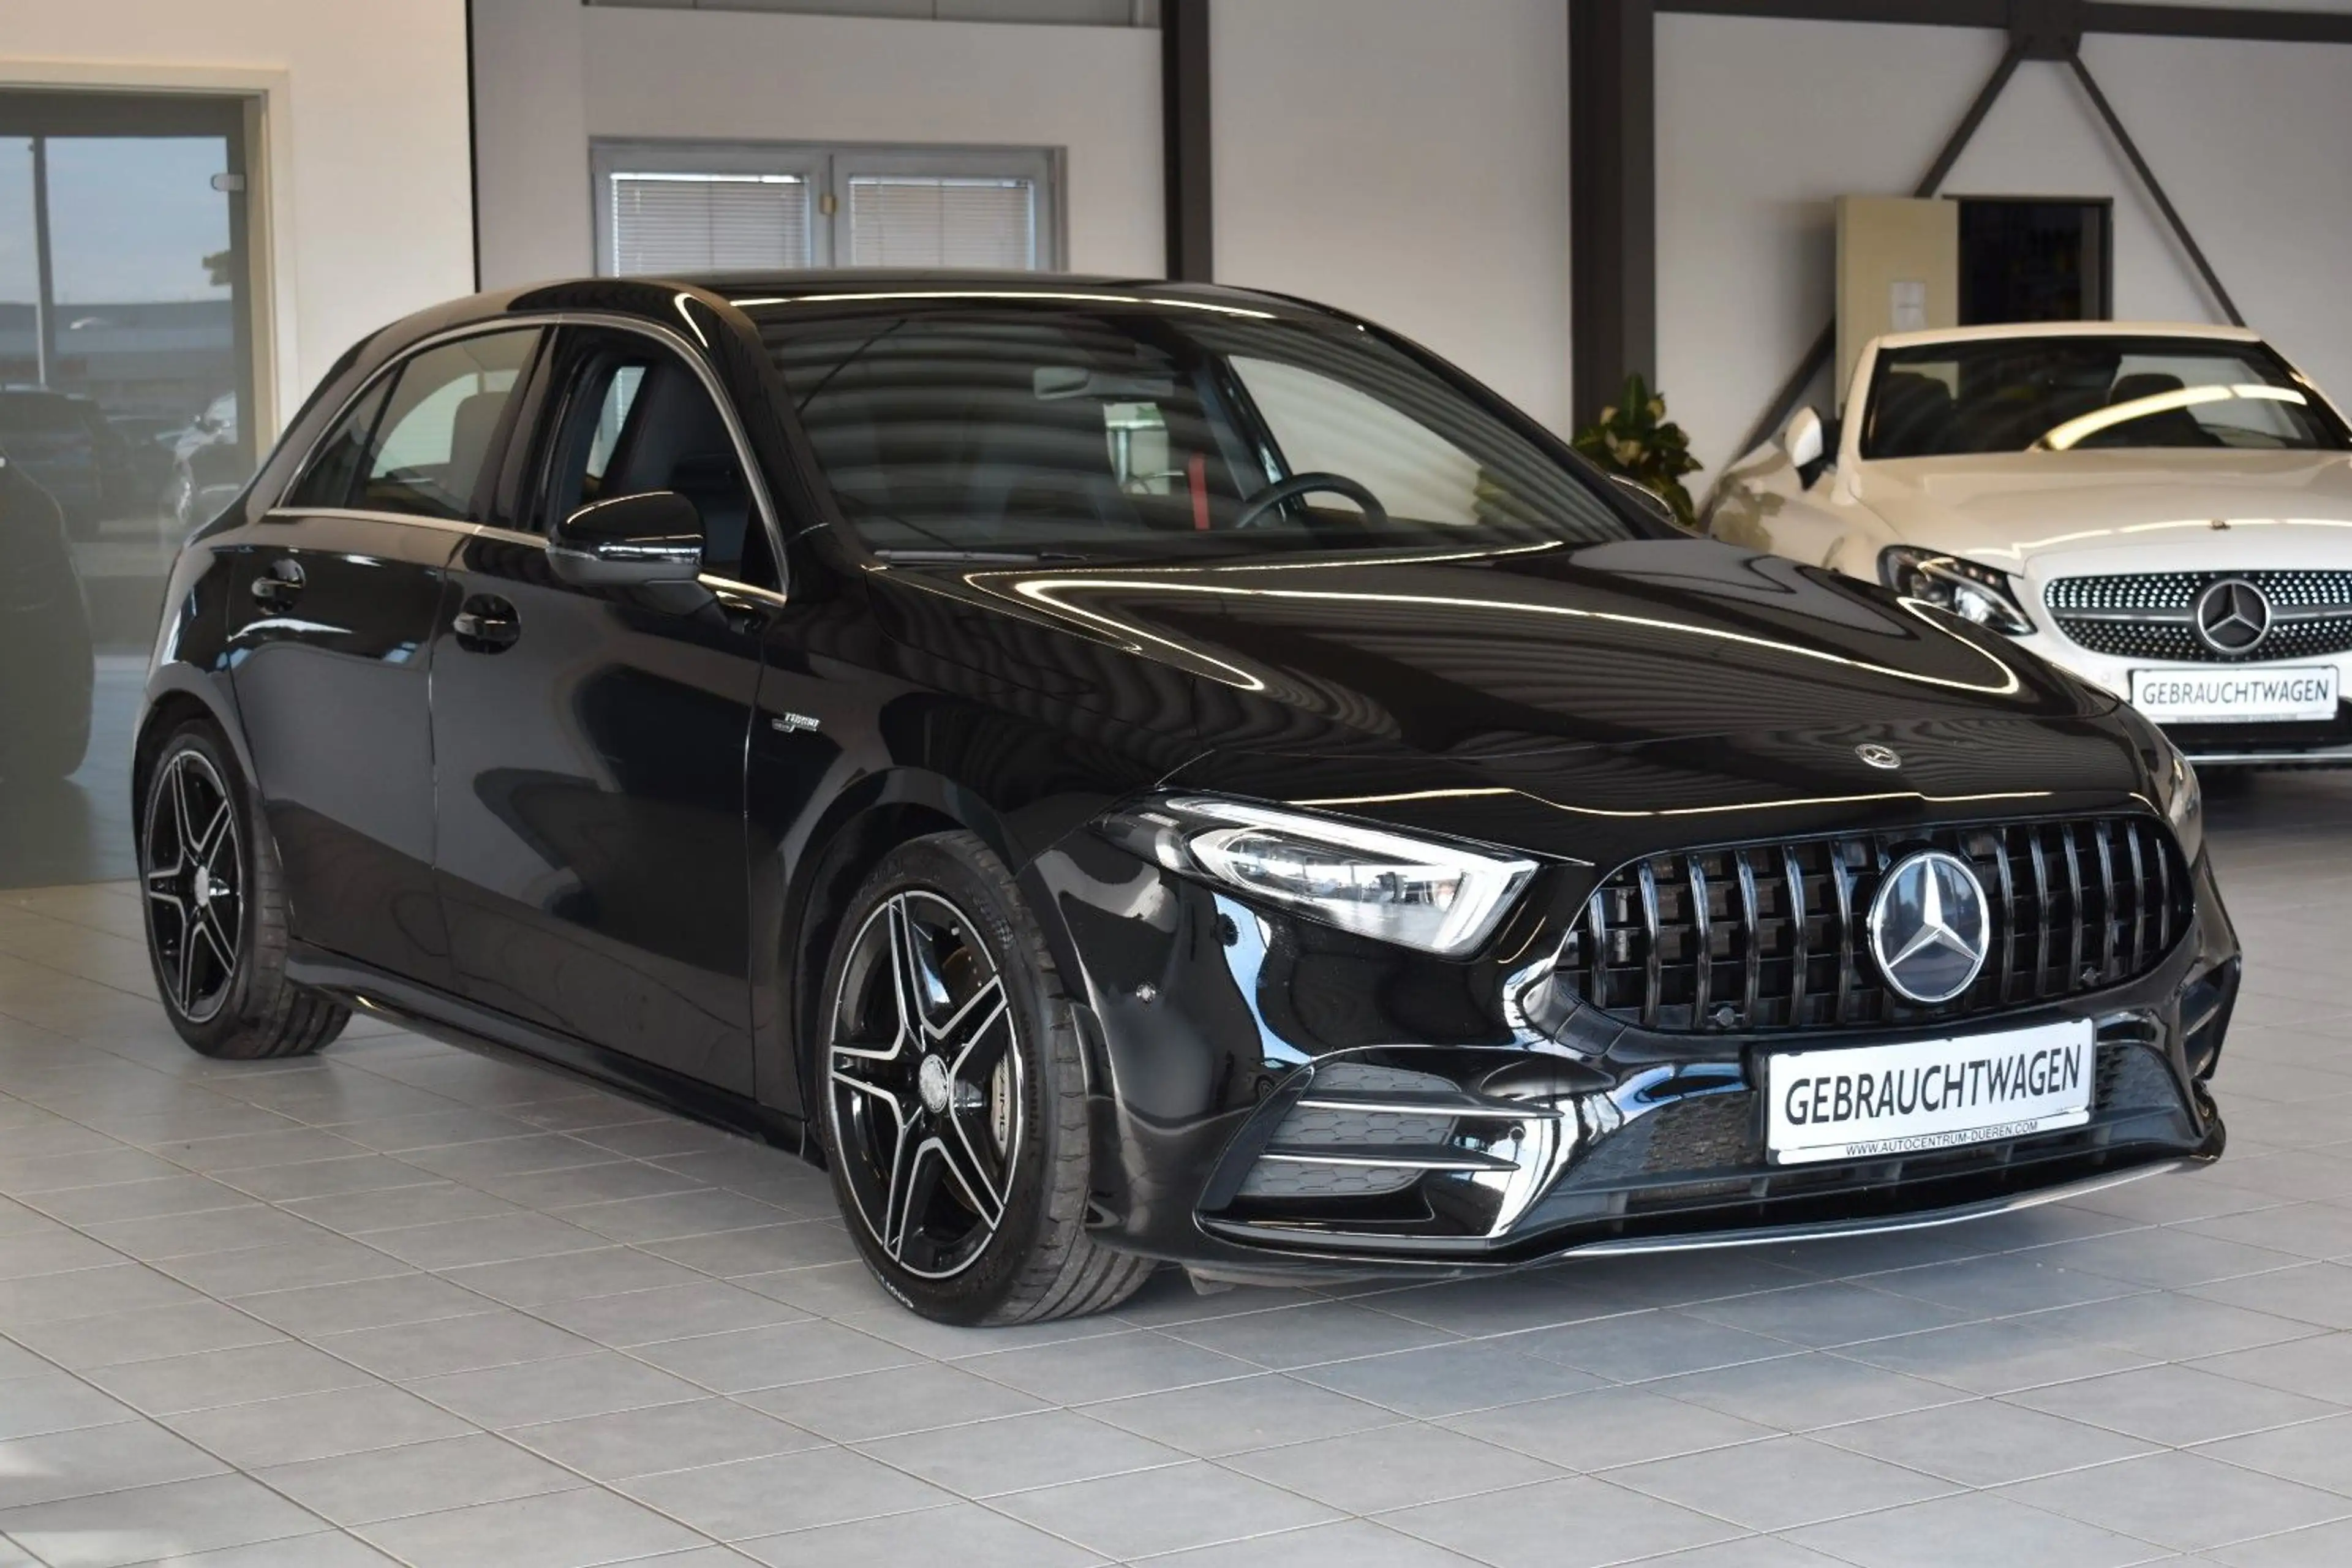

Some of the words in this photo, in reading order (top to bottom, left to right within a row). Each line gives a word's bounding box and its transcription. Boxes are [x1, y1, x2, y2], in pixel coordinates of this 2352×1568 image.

[2143, 679, 2329, 705] GEBRAUCHTWAGEN
[1785, 1044, 2081, 1125] GEBRAUCHTWAGEN
[1845, 1121, 2038, 1156] WWW.AUTOCENTRUM-DUEREN.COM
